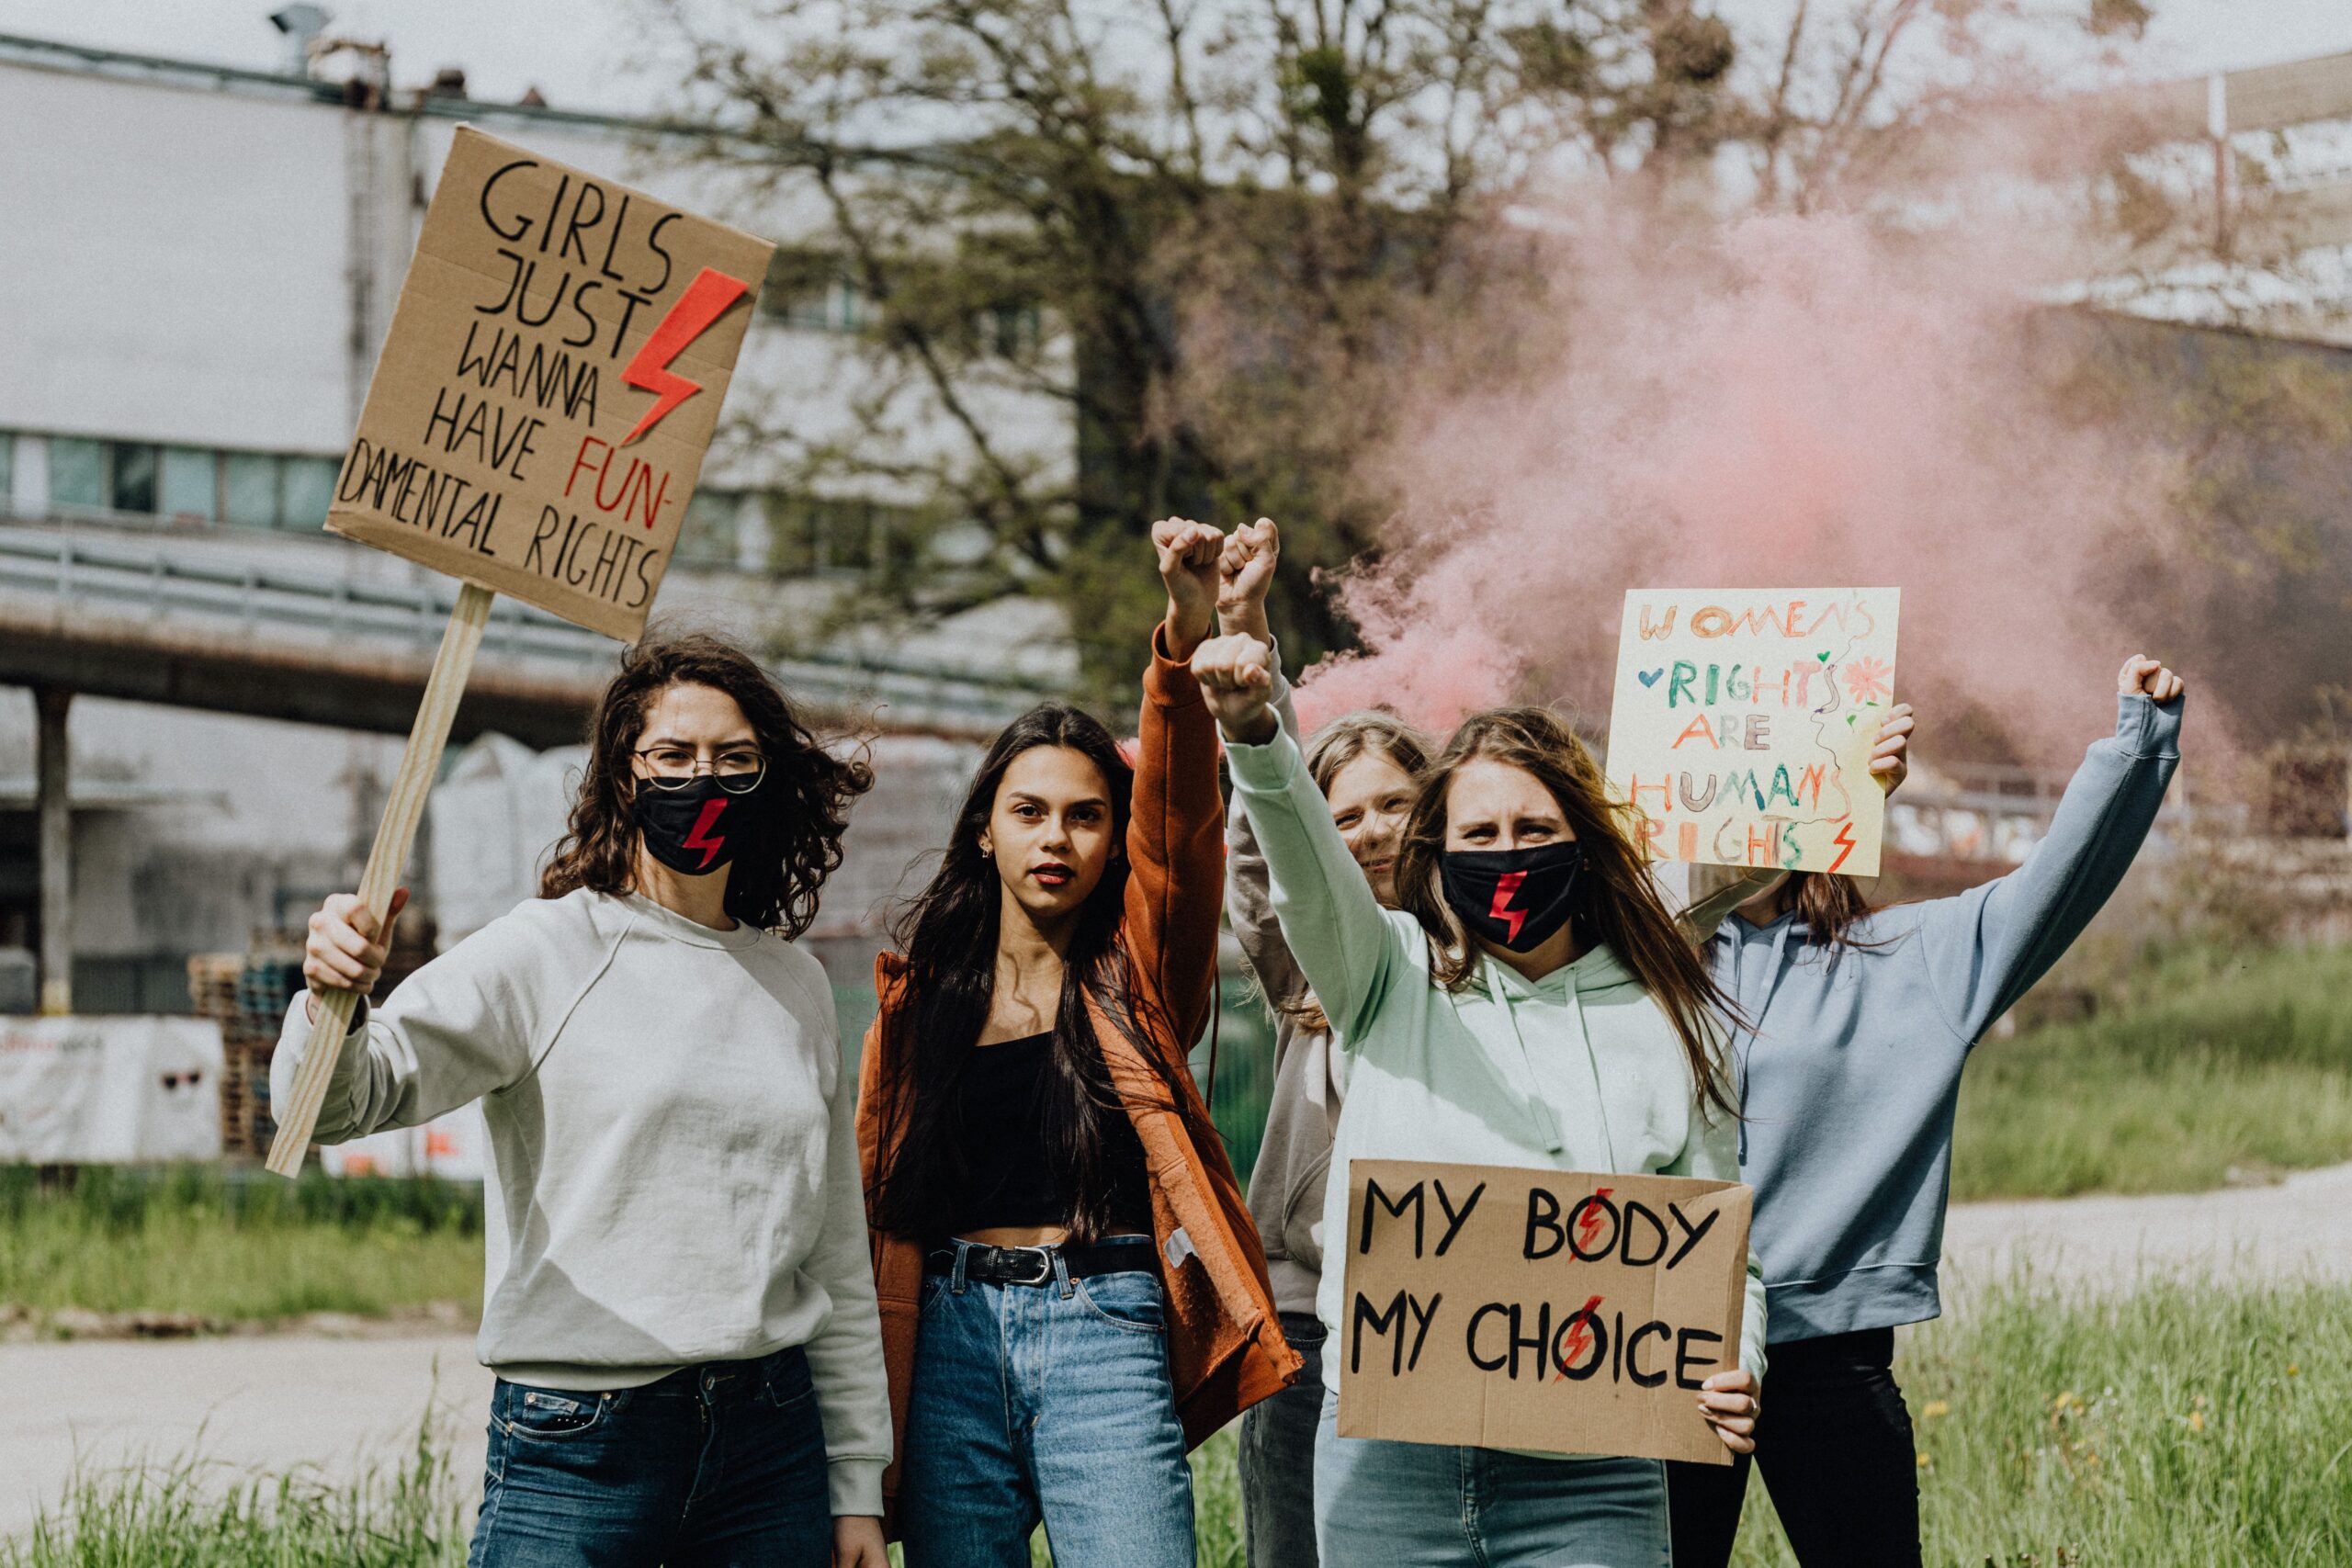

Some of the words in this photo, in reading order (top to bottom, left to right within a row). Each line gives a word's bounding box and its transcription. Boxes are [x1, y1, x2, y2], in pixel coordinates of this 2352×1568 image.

[481, 160, 683, 295] GIRLS
[474, 248, 652, 359] JUST
[458, 321, 600, 427] WANNA
[424, 387, 547, 480] HAVE
[564, 435, 673, 529] FUN-
[339, 437, 503, 556] DAMENTAL
[524, 504, 660, 608] RIGHTS
[1668, 660, 1841, 714] RIGHTS
[1670, 713, 1770, 750] ARE
[1634, 816, 1803, 870] RIGHTS
[1360, 1177, 1487, 1259] MY
[1523, 1187, 1721, 1269] BODY
[1351, 1289, 1442, 1377] MY
[1466, 1297, 1724, 1391] CHOICE
